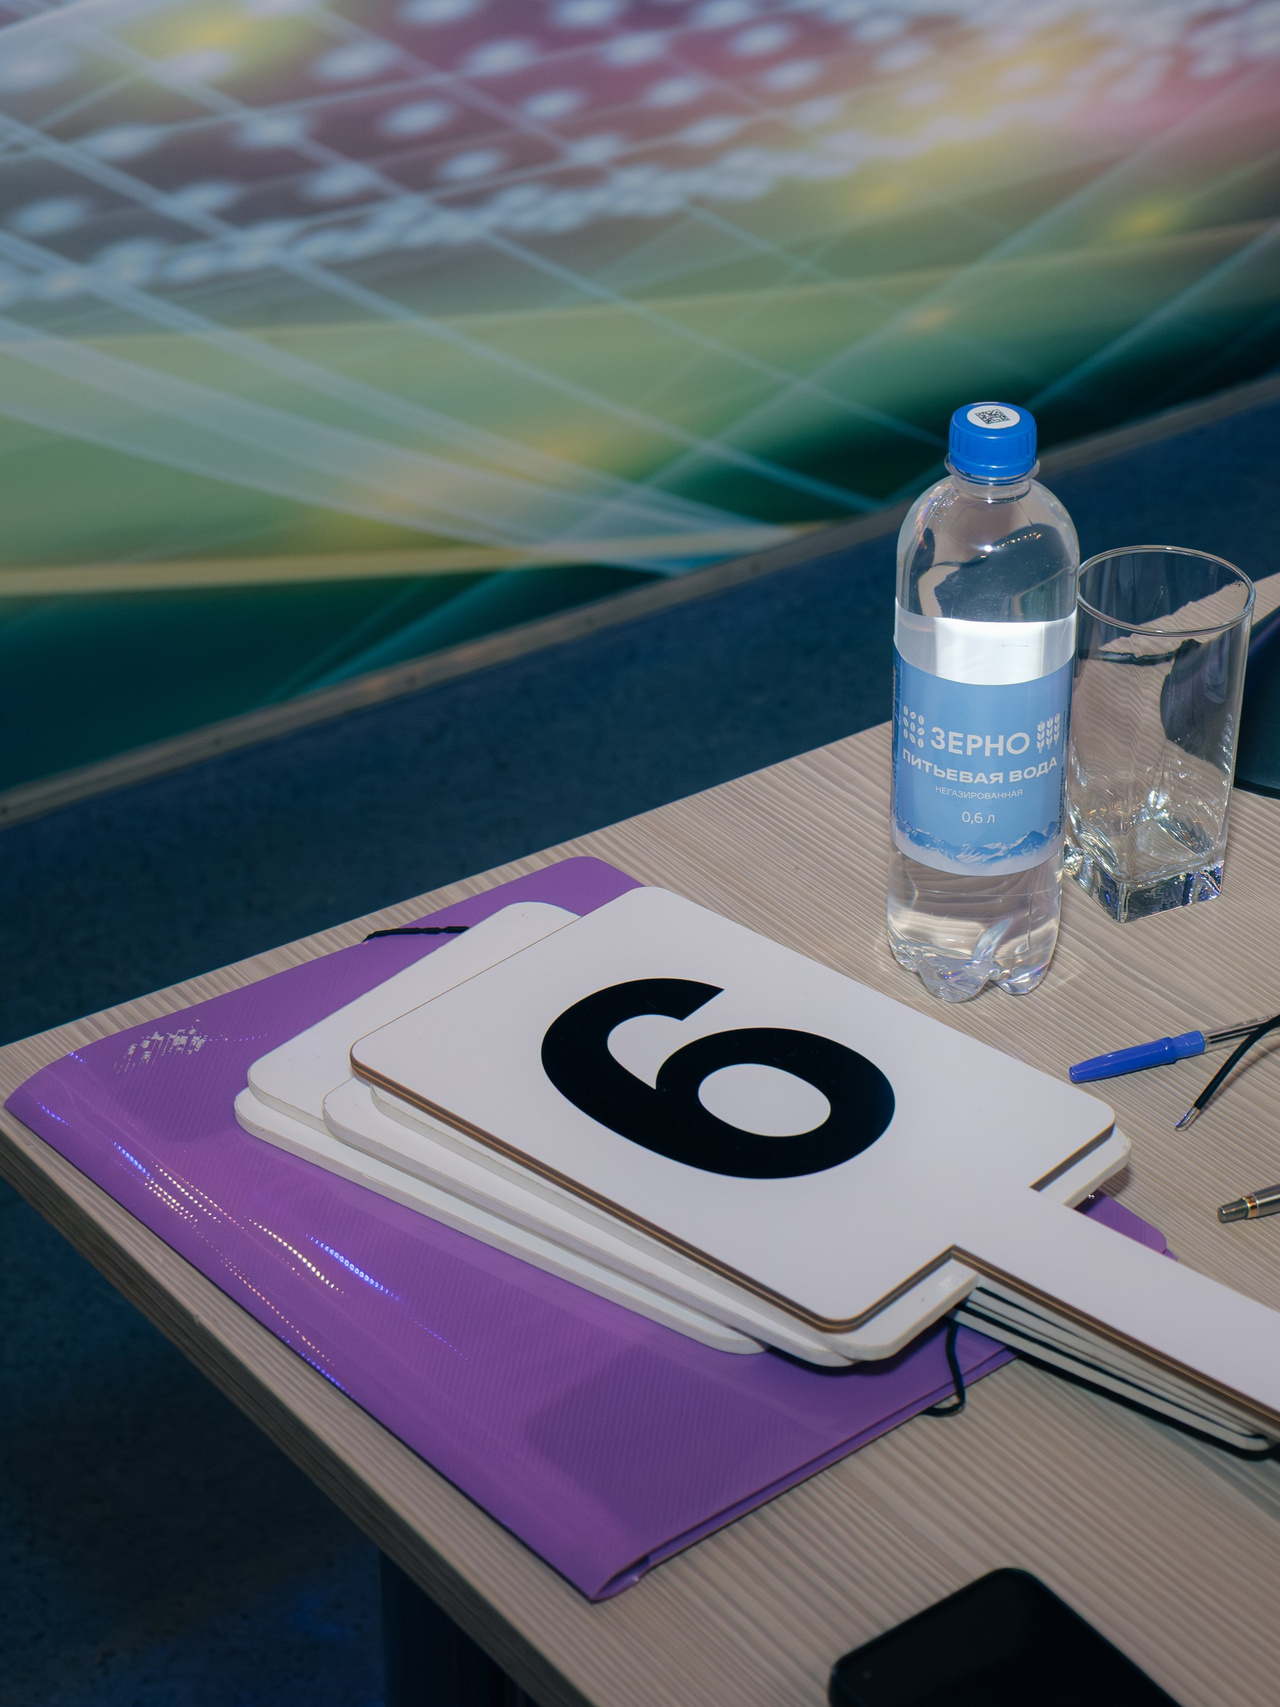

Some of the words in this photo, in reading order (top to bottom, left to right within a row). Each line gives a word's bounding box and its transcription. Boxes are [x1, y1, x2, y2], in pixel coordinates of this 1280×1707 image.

[930, 727, 1030, 757] ЗЕРНО
[902, 747, 1004, 785] ПИТЬЕВАЯ
[1009, 756, 1058, 783] ВОДА
[935, 785, 1023, 800] НЕГАЗИРОВАННАЯ
[961, 811, 983, 825] 0,6
[987, 813, 995, 824] л
[542, 979, 895, 1178] 6
